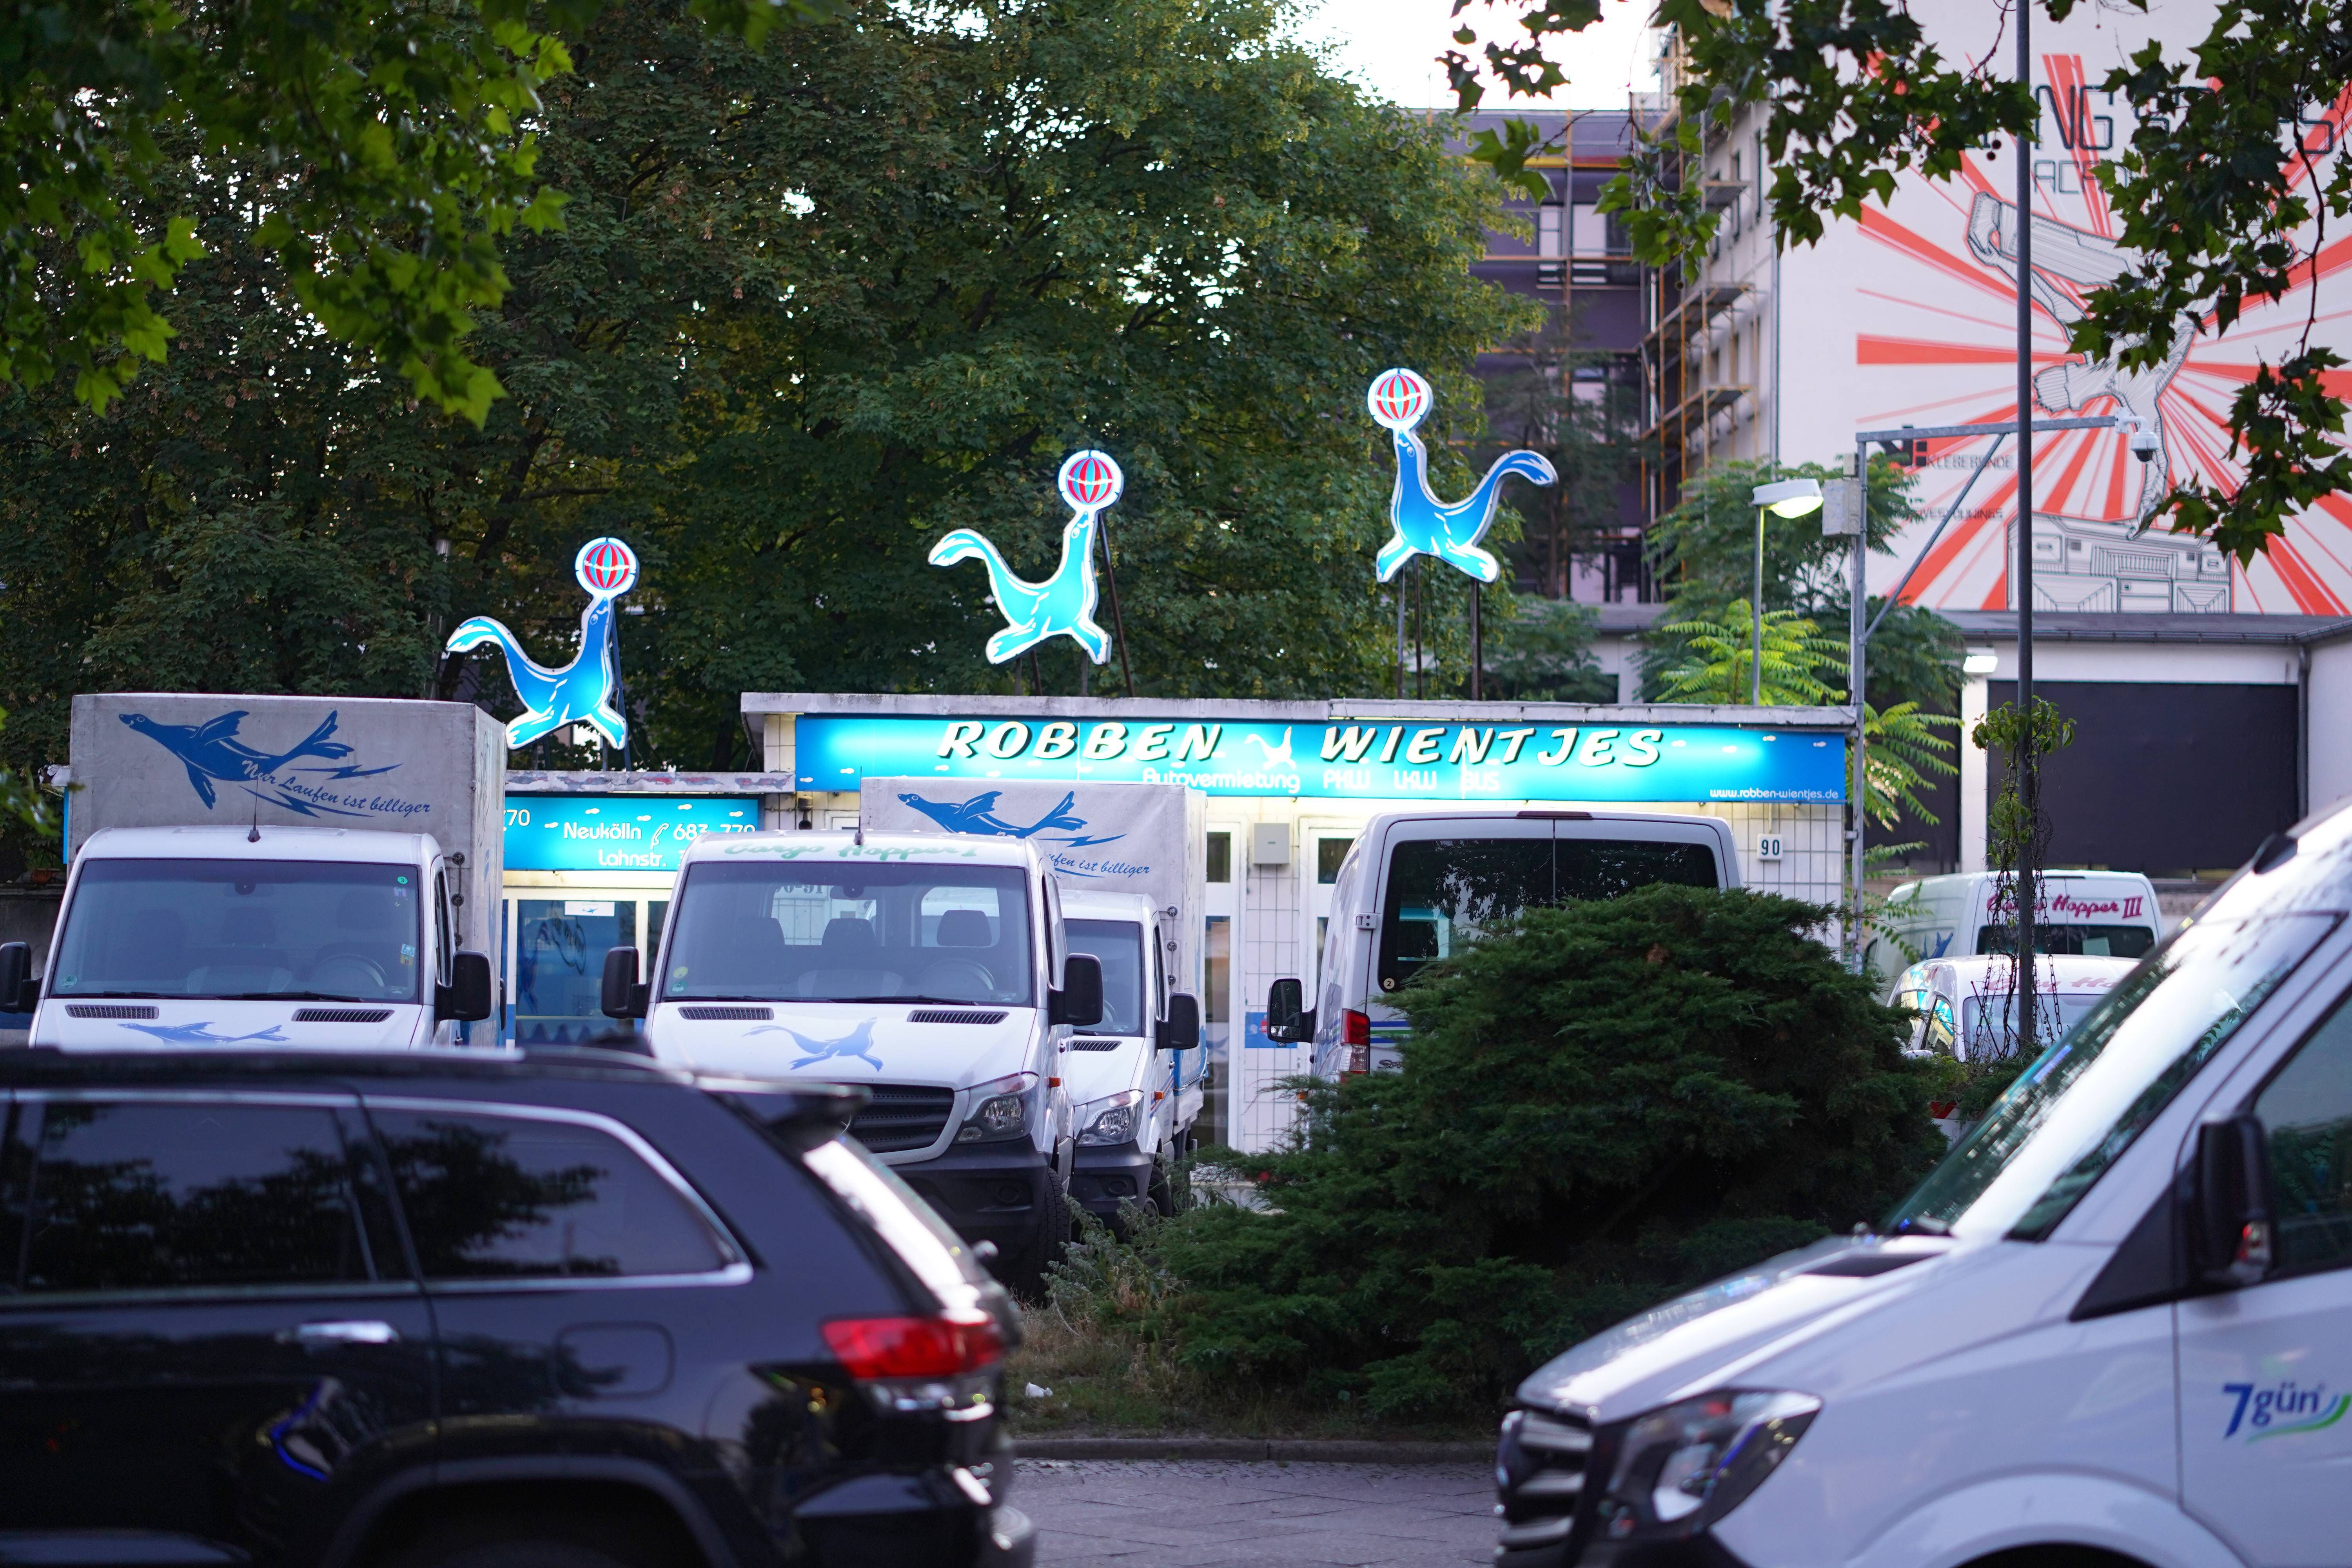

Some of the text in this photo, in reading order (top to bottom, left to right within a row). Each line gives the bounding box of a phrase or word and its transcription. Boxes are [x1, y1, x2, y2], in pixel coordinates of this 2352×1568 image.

[936, 721, 1662, 766] ROBBEN WIENTJES
[242, 760, 431, 818] Nur Laufen ist billiger
[1142, 767, 1300, 794] Autovermietung
[1323, 769, 1370, 789] PKW
[1710, 787, 1838, 800] www.robben-wientjes.de
[503, 809, 531, 826] 70
[564, 821, 642, 840] Neukölln
[724, 842, 826, 859] Cargo
[838, 843, 960, 861] Hopper
[1761, 839, 1780, 855] 90
[599, 848, 667, 867] Lahnstr.
[1079, 860, 1098, 871] ist
[1101, 861, 1150, 878] billiger
[2052, 893, 2119, 919] Hopper
[2122, 895, 2144, 919] III
